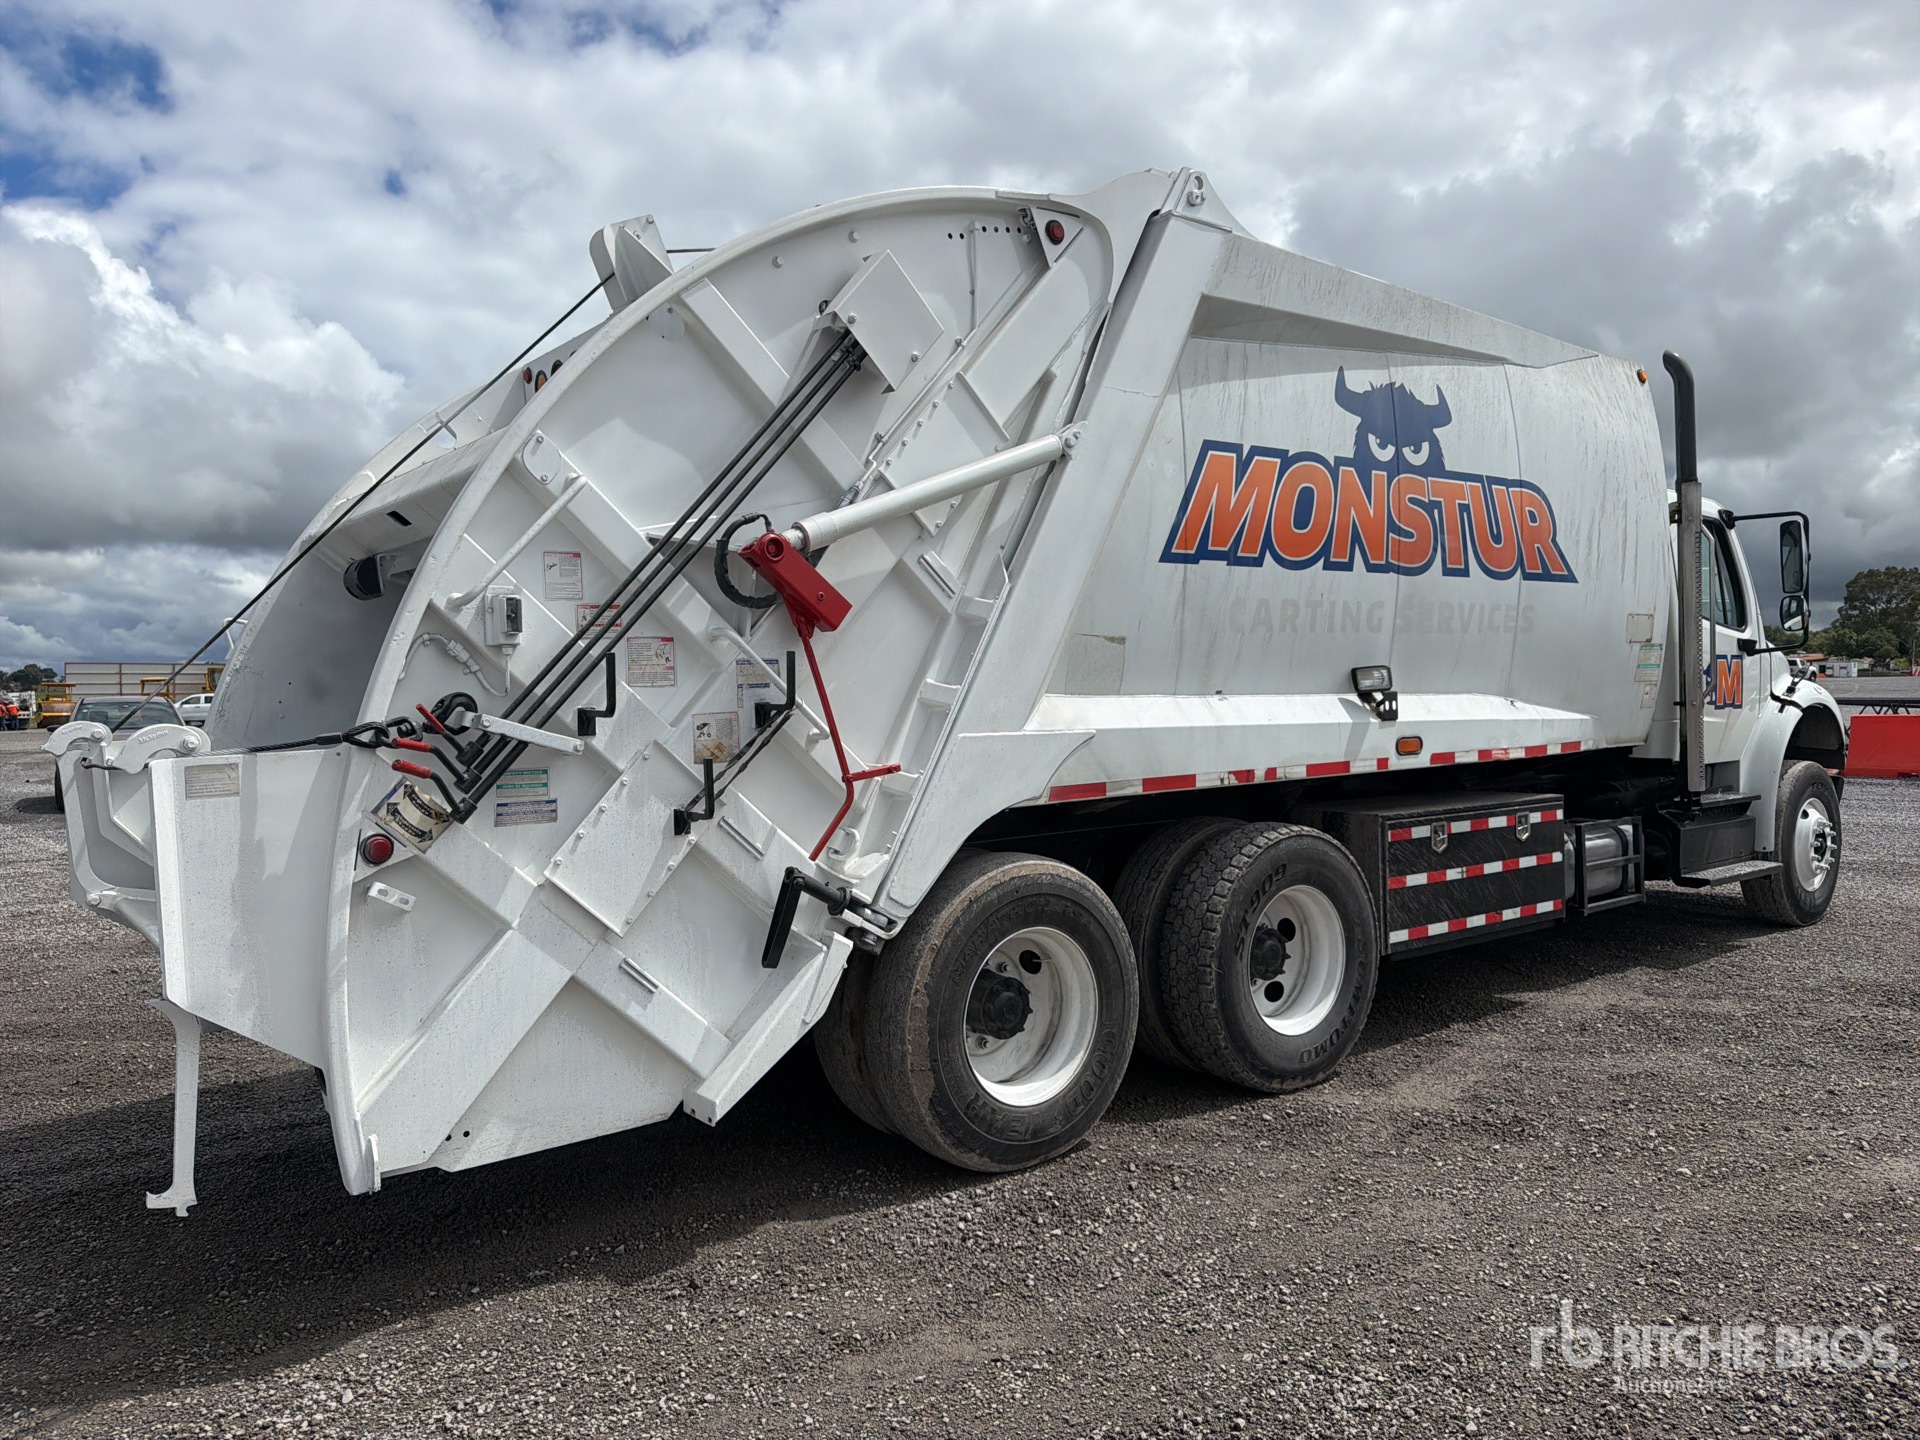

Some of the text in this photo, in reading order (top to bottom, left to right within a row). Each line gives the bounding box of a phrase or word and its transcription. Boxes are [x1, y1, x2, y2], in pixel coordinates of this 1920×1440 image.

[1165, 445, 1574, 580] MONSTUR
[1227, 597, 1536, 635] CARTING SERVICES
[1236, 863, 1287, 961] ST909
